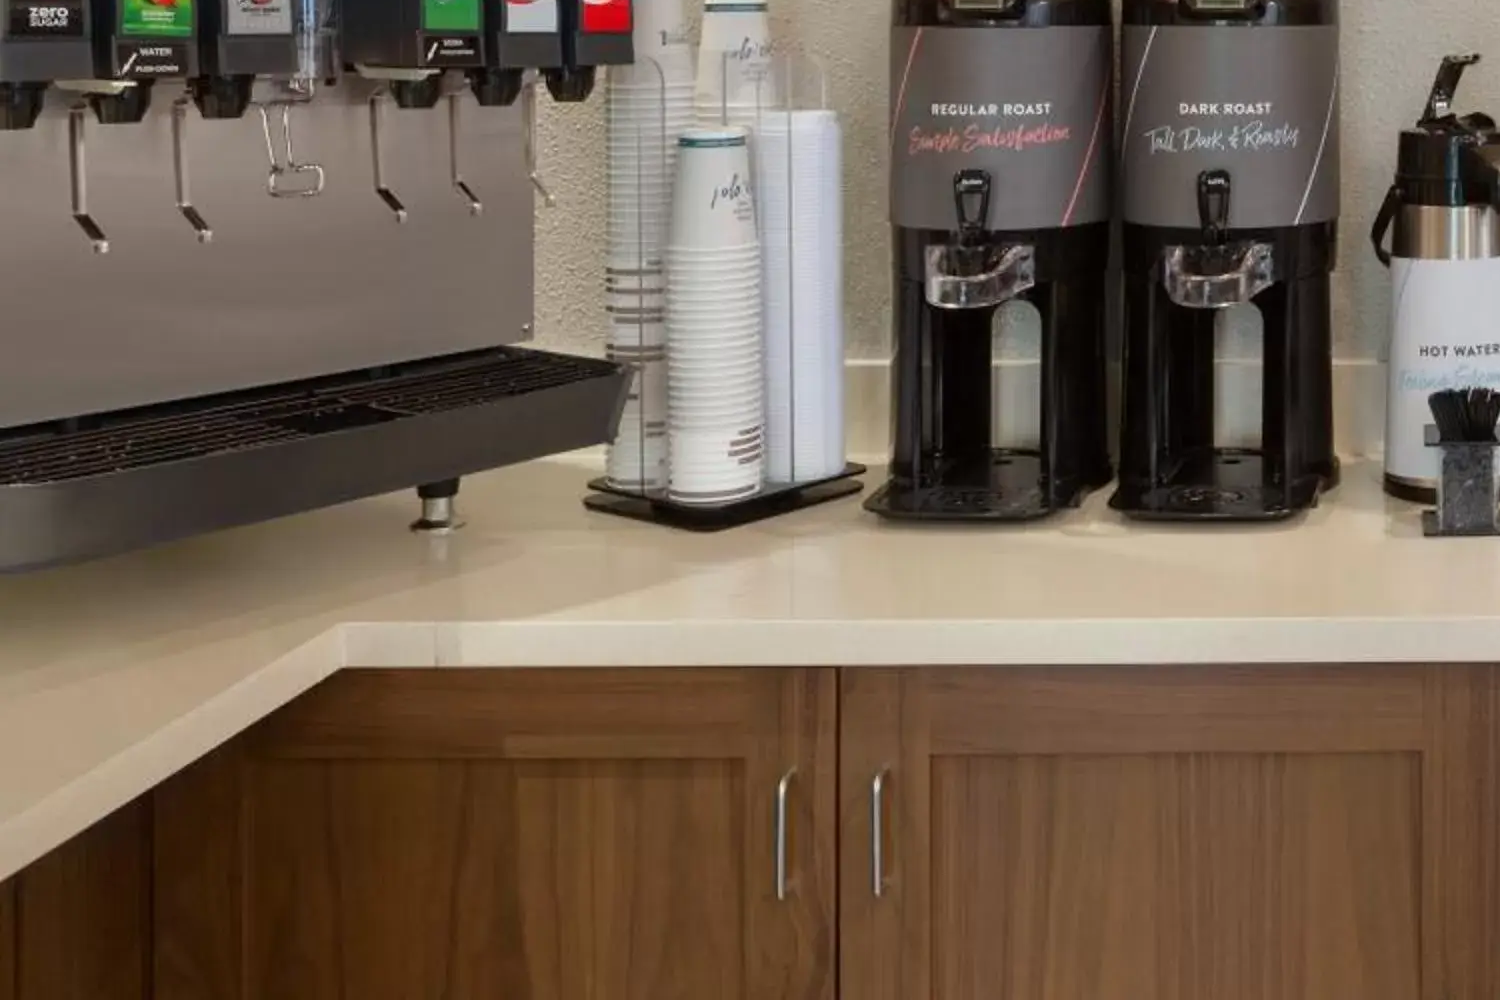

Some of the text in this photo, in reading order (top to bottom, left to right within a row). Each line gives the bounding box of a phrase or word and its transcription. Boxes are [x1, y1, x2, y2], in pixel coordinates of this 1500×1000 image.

[29, 6, 69, 17] zero
[29, 17, 69, 27] SUGAR
[139, 47, 173, 57] WATER
[931, 103, 1051, 116] REGULAR ROAST
[1179, 103, 1273, 115] DARK ROAST
[1419, 345, 1449, 357] HOT
